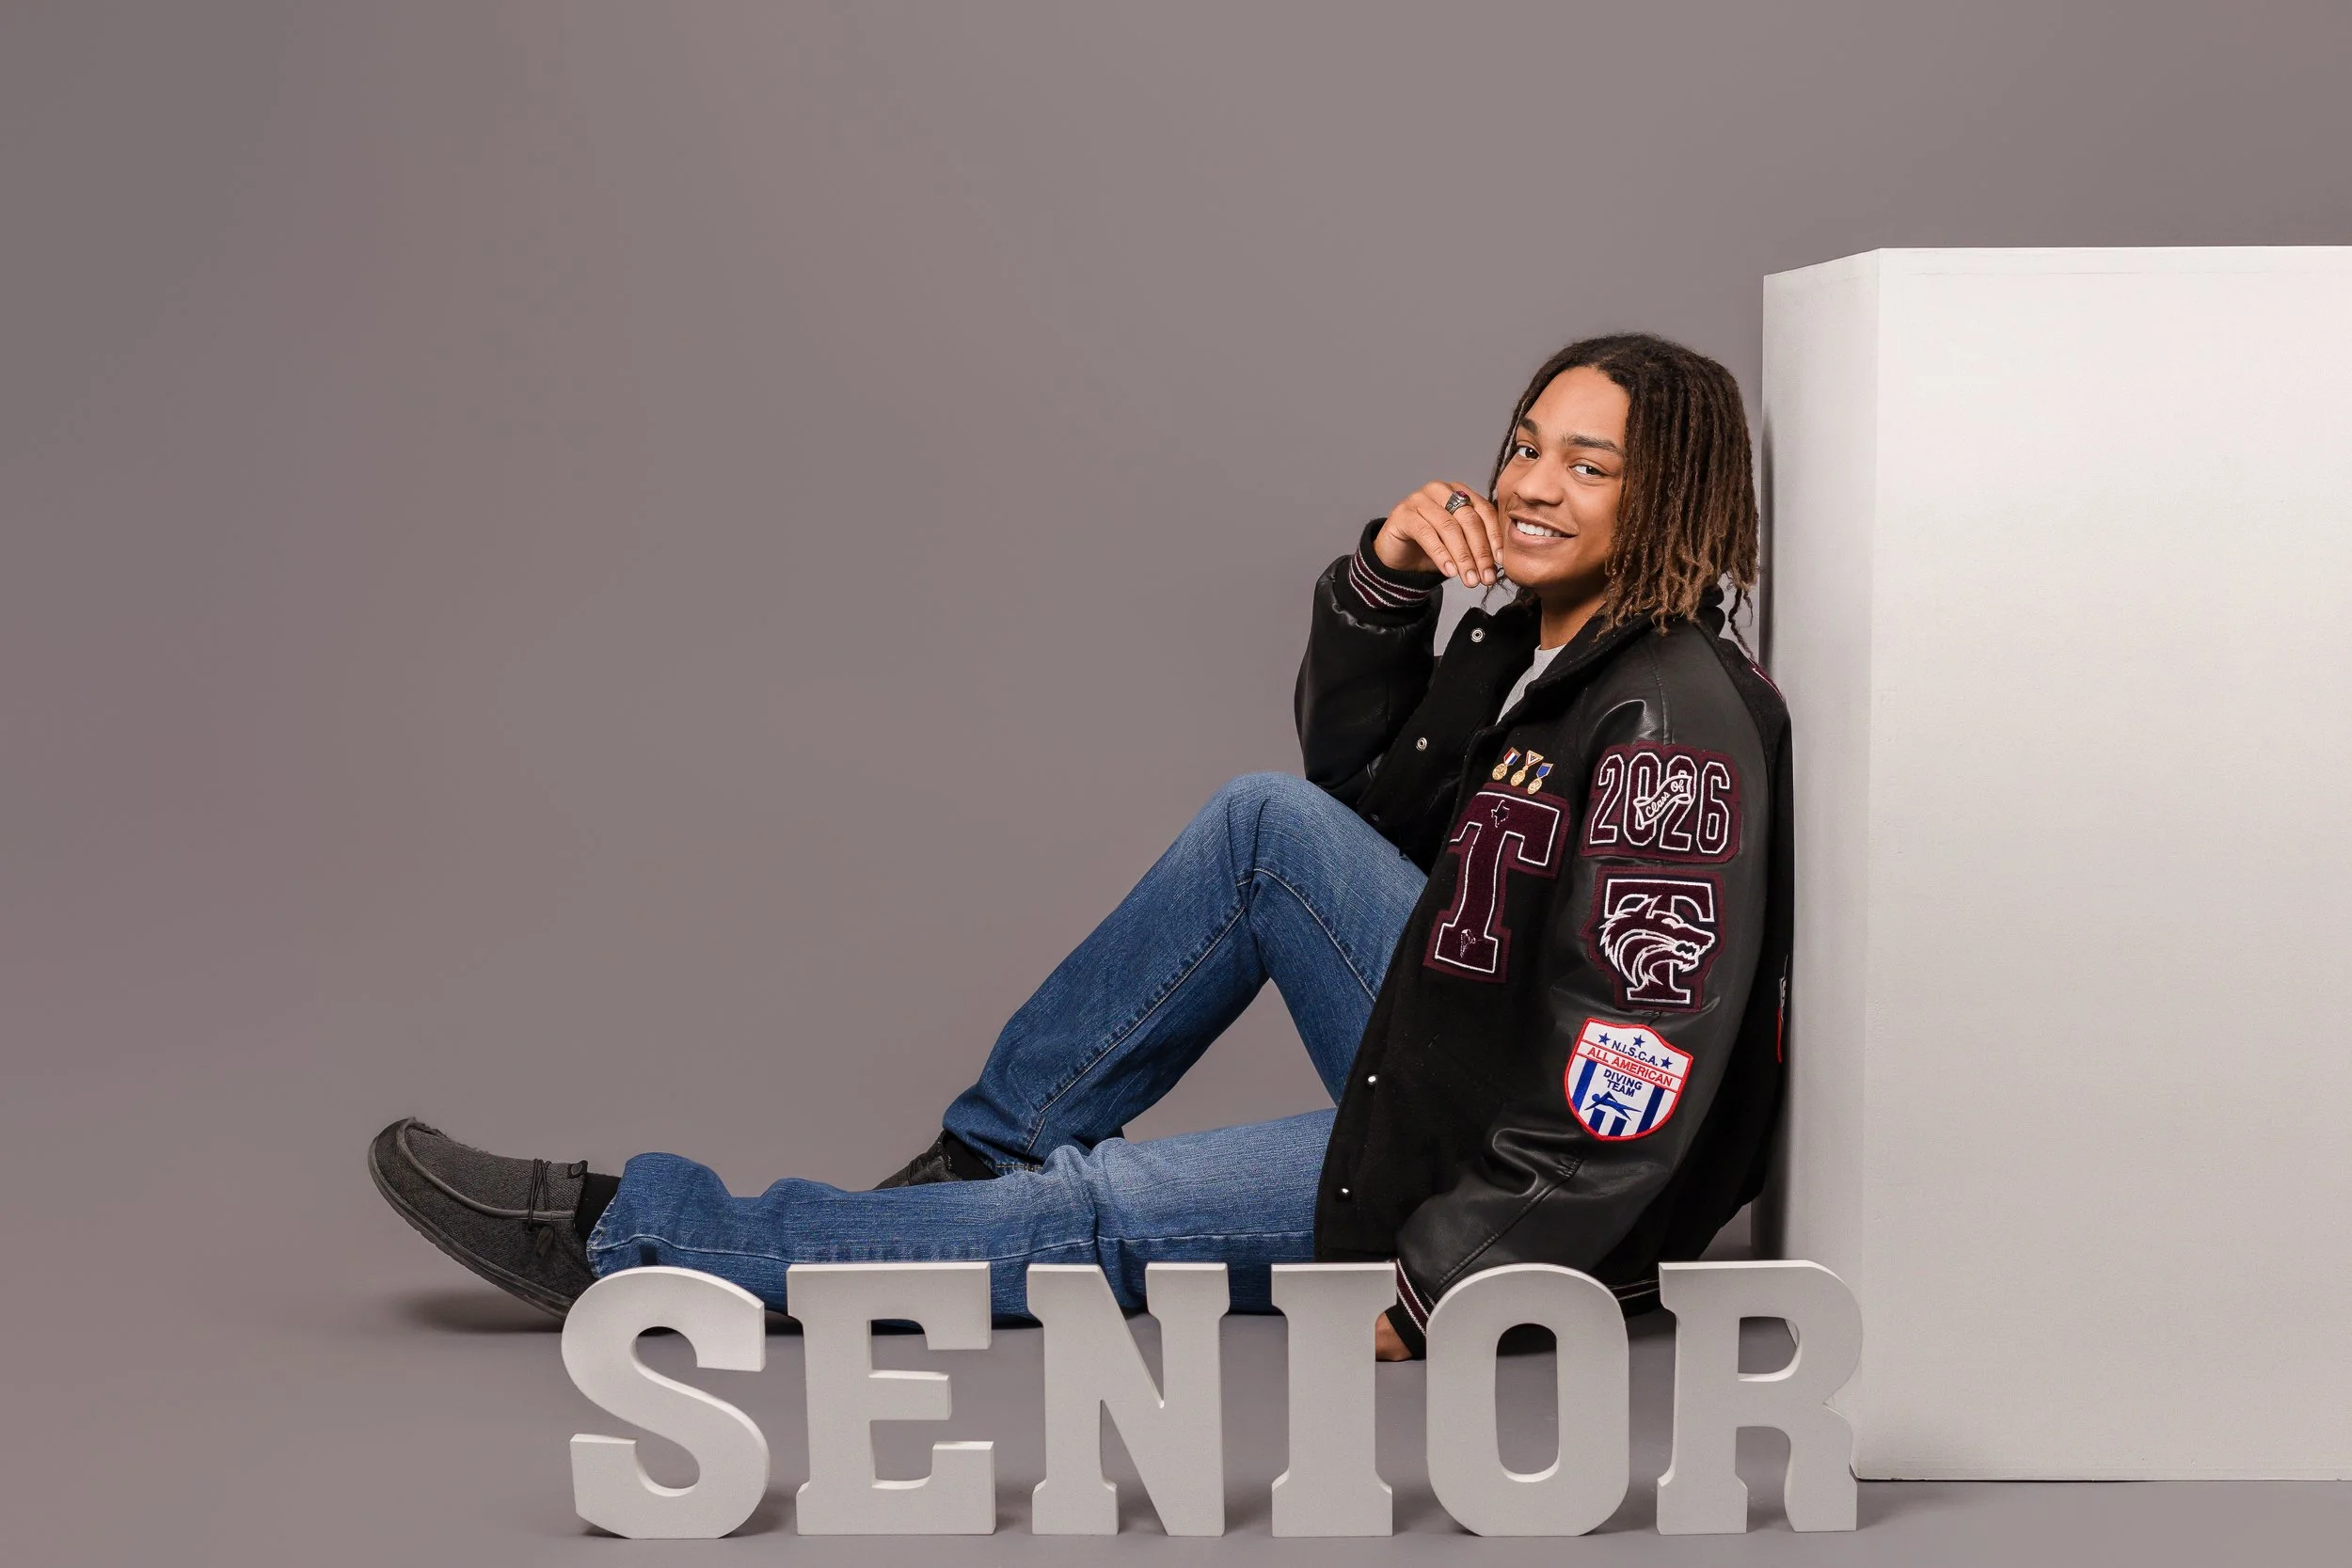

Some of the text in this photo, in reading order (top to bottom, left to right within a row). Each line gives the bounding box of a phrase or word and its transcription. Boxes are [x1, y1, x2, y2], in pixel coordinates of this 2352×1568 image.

[1589, 752, 1730, 854] 2026
[1645, 792, 1671, 817] Class
[1449, 791, 1561, 973] T
[1587, 1047, 1673, 1087] ALL AMERICAN
[1612, 1040, 1659, 1066] N.I.S.C.A.
[1603, 1069, 1643, 1091] DIVING
[1607, 1080, 1636, 1098] TEAM
[562, 1261, 1863, 1539] SENIOR
